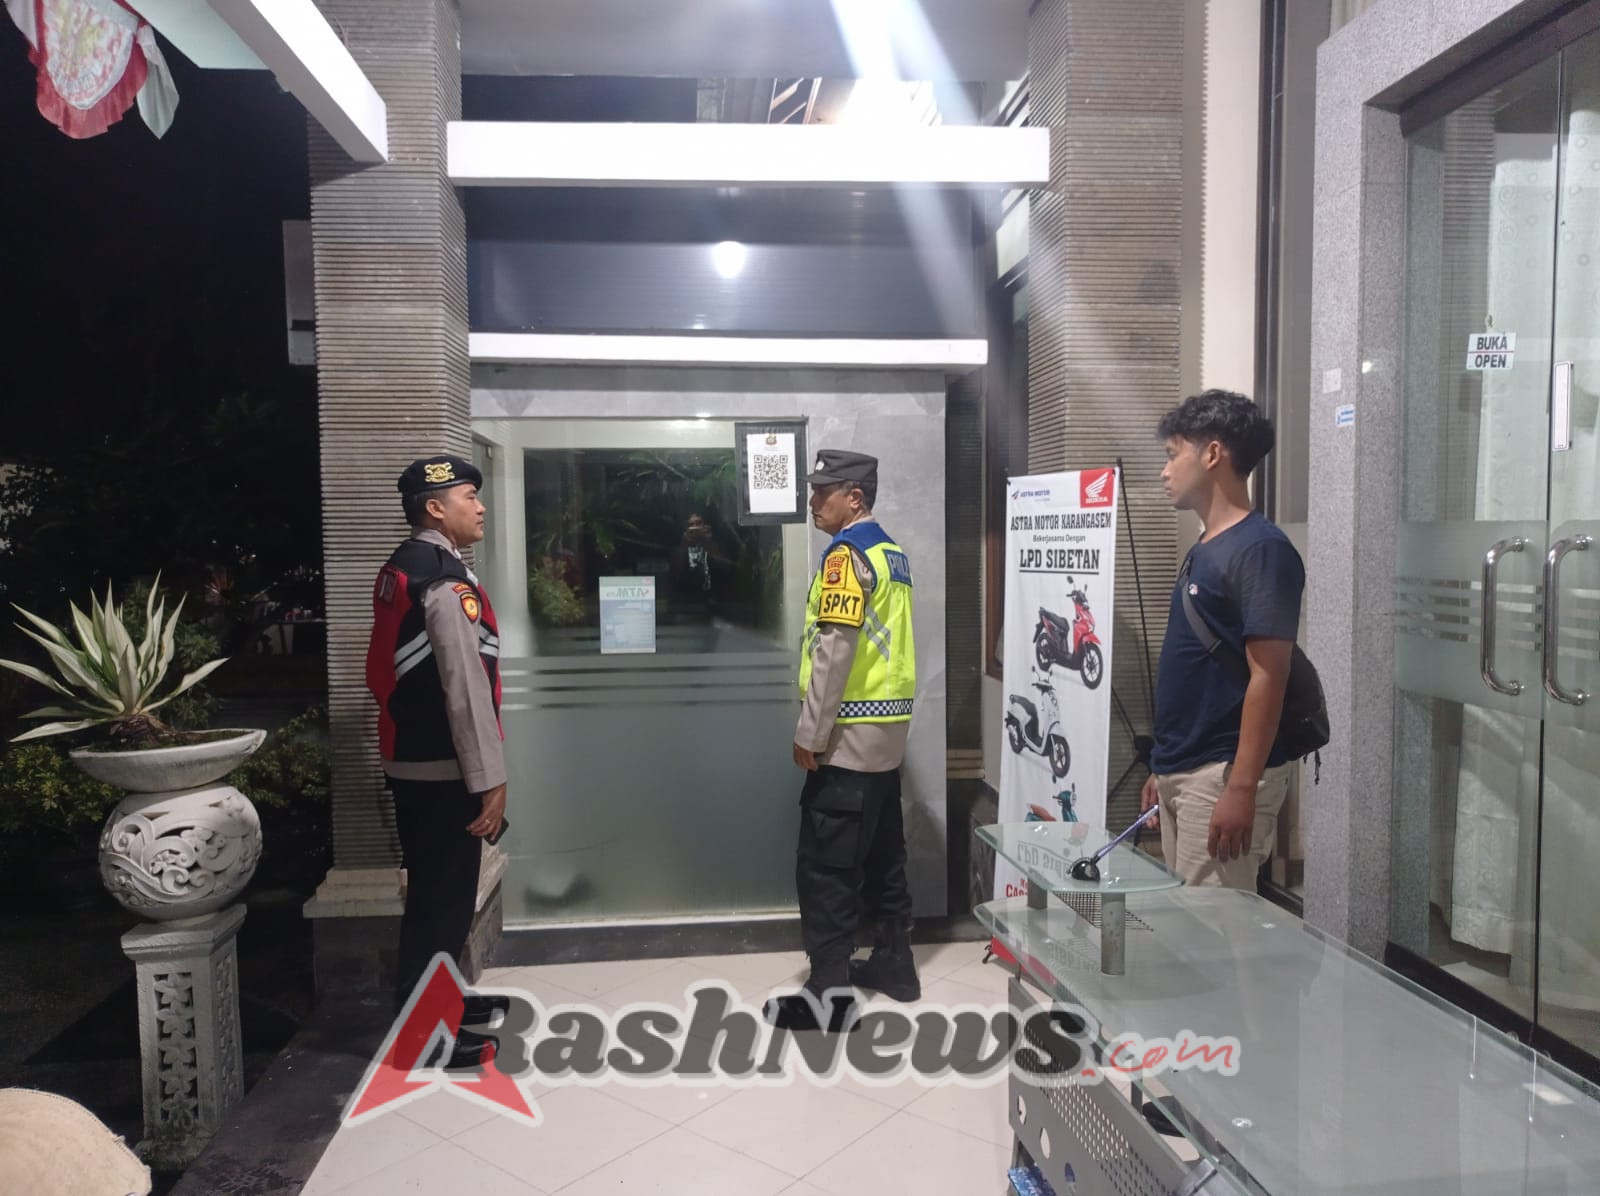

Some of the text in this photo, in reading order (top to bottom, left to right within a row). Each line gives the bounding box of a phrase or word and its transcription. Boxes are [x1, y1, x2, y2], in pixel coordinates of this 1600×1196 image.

[1477, 336, 1508, 350] BUKA
[1474, 354, 1507, 368] OPEN
[1020, 489, 1051, 498] ASTRA MOTOR
[1085, 496, 1109, 504] HONDA
[1010, 512, 1112, 531] ASTRA MOTOR KARANGASEM
[1033, 534, 1086, 544] Bekerjasama Dengan
[1020, 549, 1100, 570] LPD SIBETAN
[823, 593, 861, 616] SPKT
